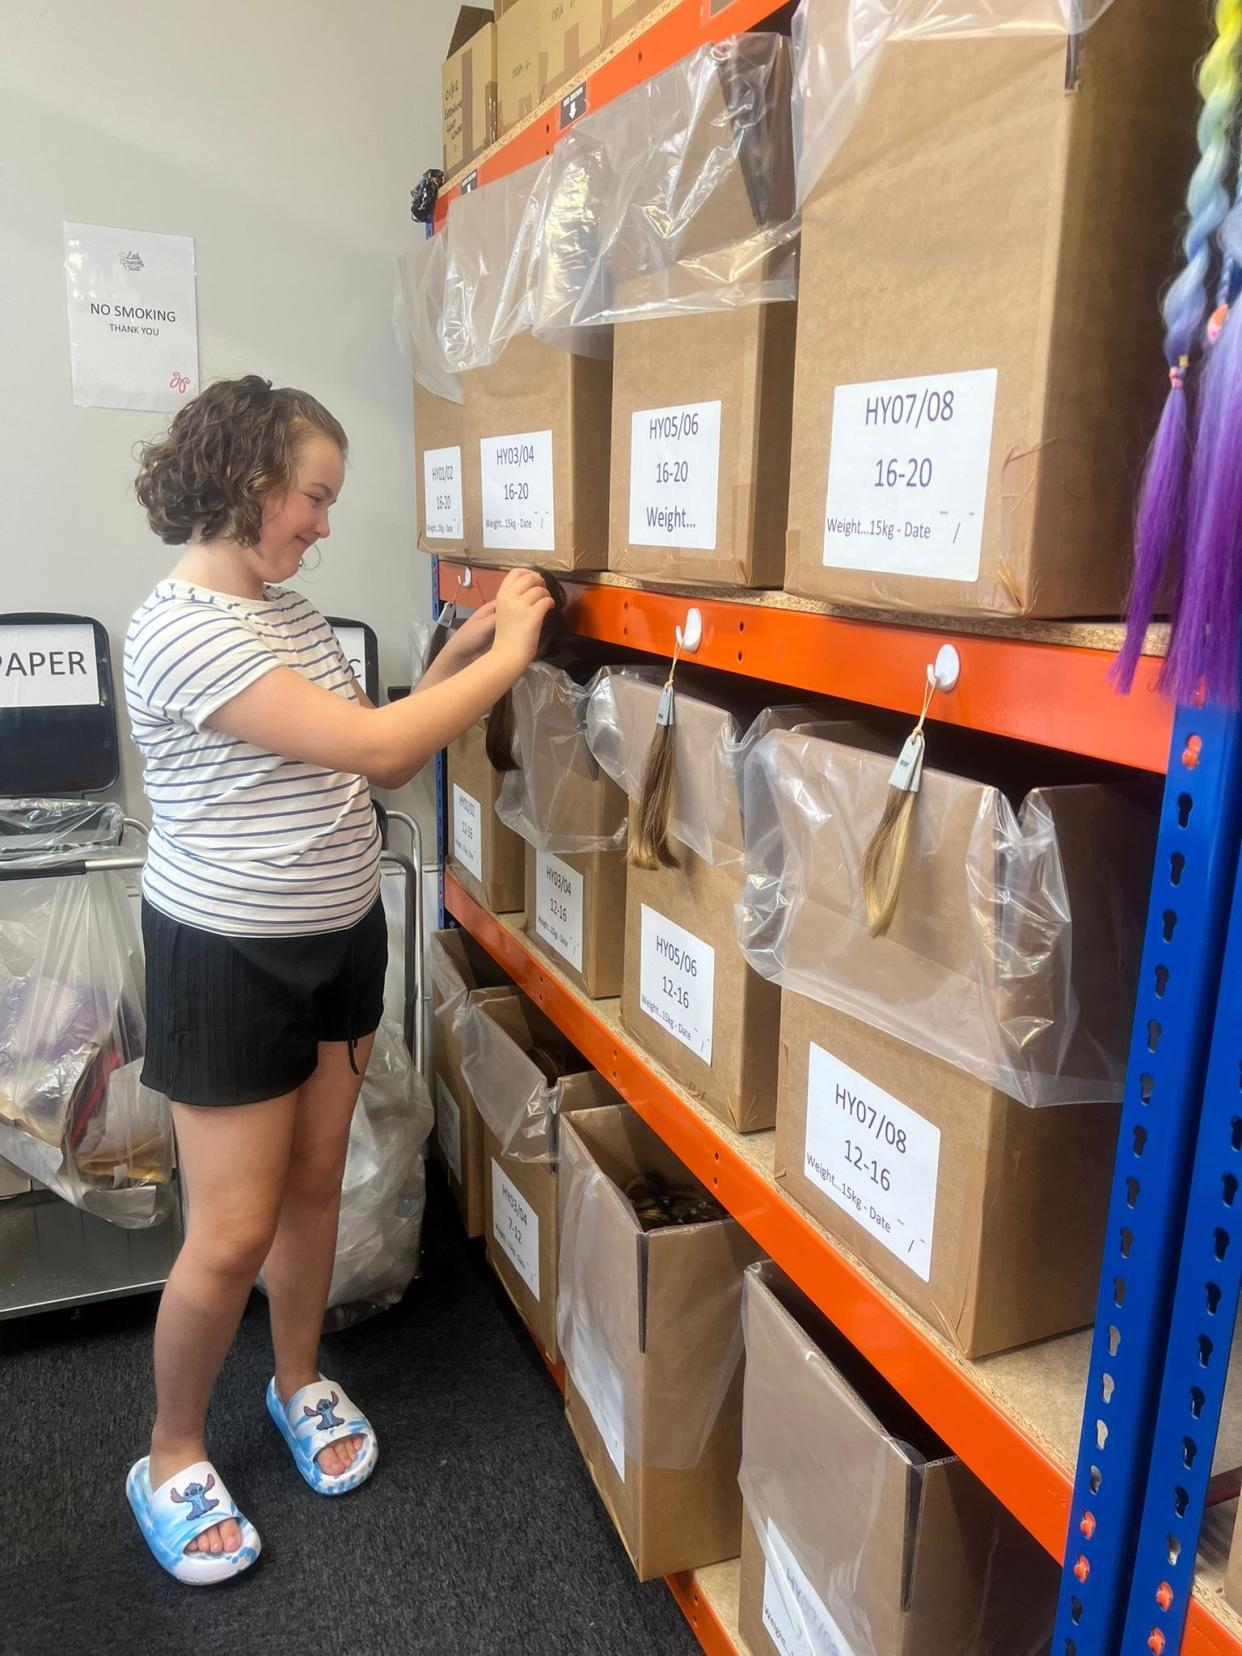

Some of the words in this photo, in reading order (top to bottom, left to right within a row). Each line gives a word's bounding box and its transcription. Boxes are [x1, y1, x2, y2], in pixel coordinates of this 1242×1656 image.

[90, 303, 111, 315] NO
[114, 305, 176, 323] SMOKING
[109, 323, 139, 334] THANK
[141, 326, 160, 336] YOU
[864, 388, 955, 429] HY07/08
[649, 411, 699, 441] HY05/06
[496, 444, 535, 468] HY03/04
[655, 460, 689, 483] 16-20
[874, 457, 933, 488] 16-20
[503, 482, 529, 500] 16-20
[646, 505, 696, 533] Weight...
[904, 520, 931, 539] Date
[656, 935, 698, 977] HY05/06
[662, 975, 690, 1009] 12-16
[678, 1022, 692, 1040] Date
[835, 1083, 908, 1154] HY07/08
[844, 1139, 891, 1192] 12-16
[868, 1205, 892, 1233] Date
